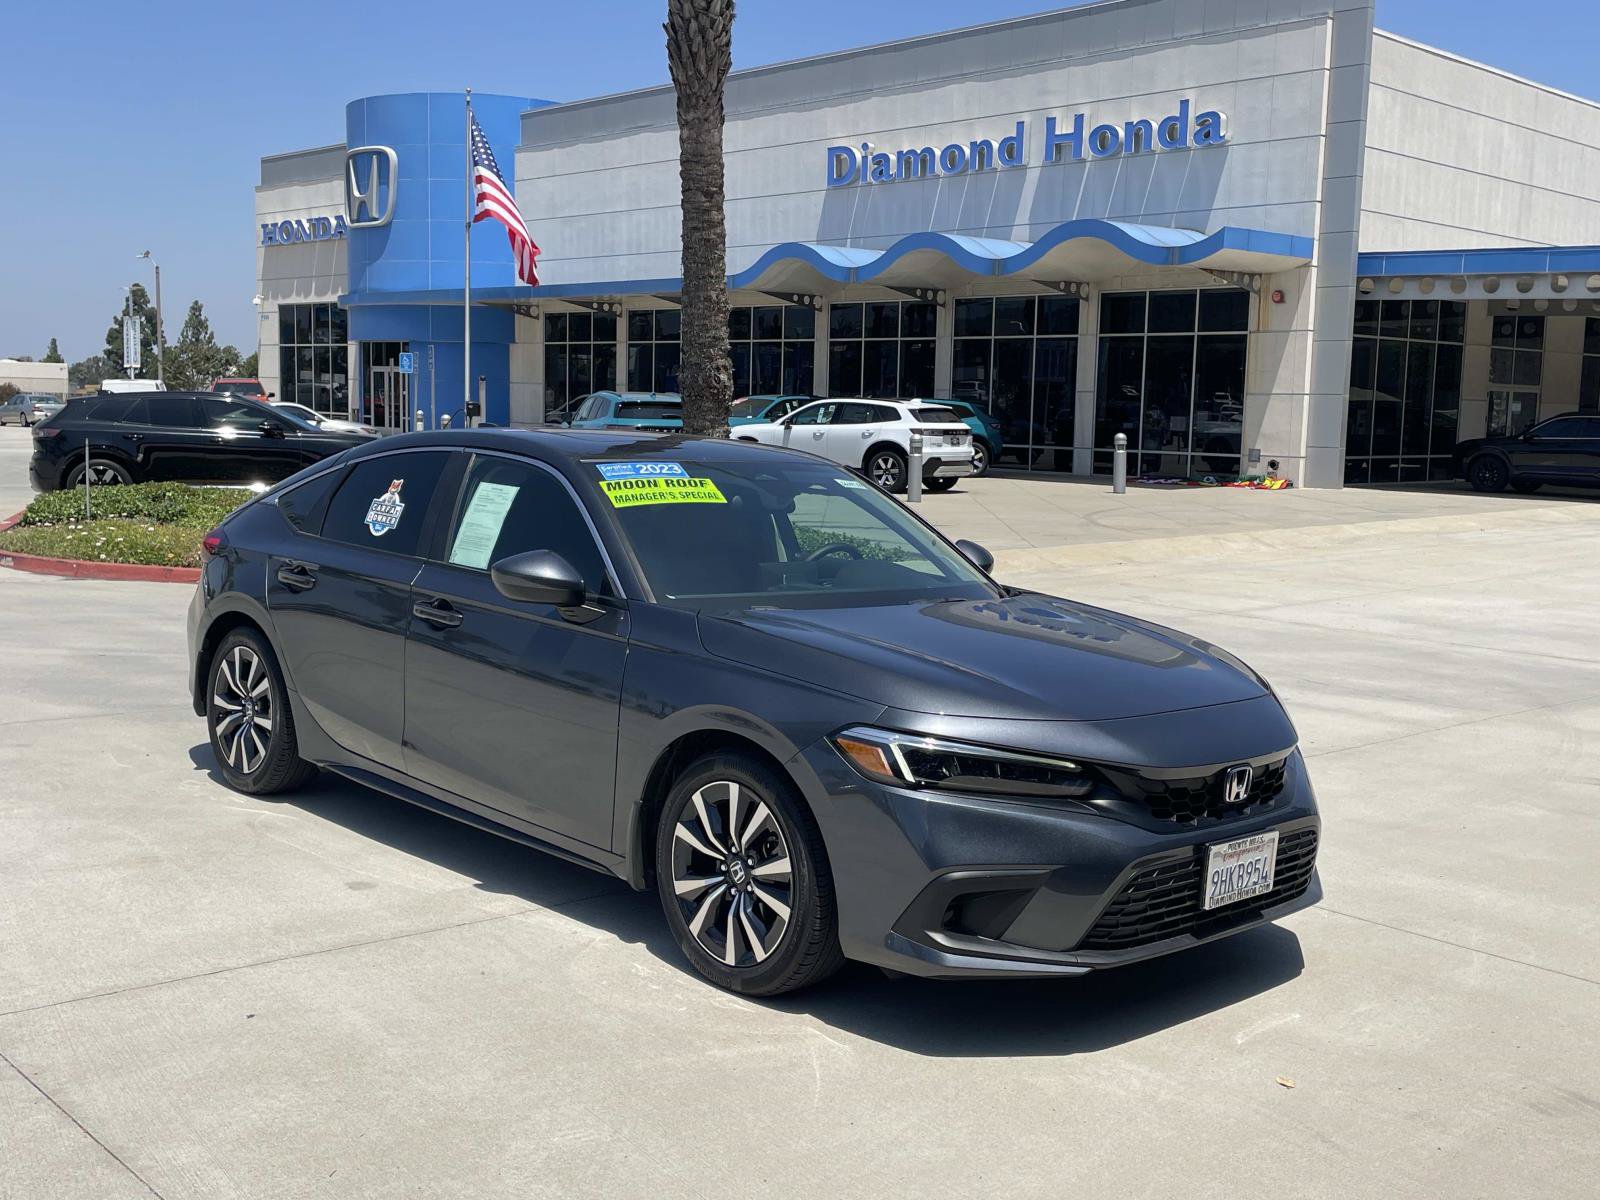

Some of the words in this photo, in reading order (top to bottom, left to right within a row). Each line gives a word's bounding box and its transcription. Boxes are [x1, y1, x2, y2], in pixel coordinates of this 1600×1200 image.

[826, 119, 1028, 188] Diamond
[1044, 98, 1227, 162] Honda
[261, 214, 347, 246] HONDA
[636, 463, 682, 475] 2023
[605, 479, 658, 491] MOON
[664, 479, 708, 488] ROOF
[613, 491, 677, 504] MANAGER'S
[680, 491, 719, 500] SPECIAL
[1210, 856, 1268, 898] 9HKB954
